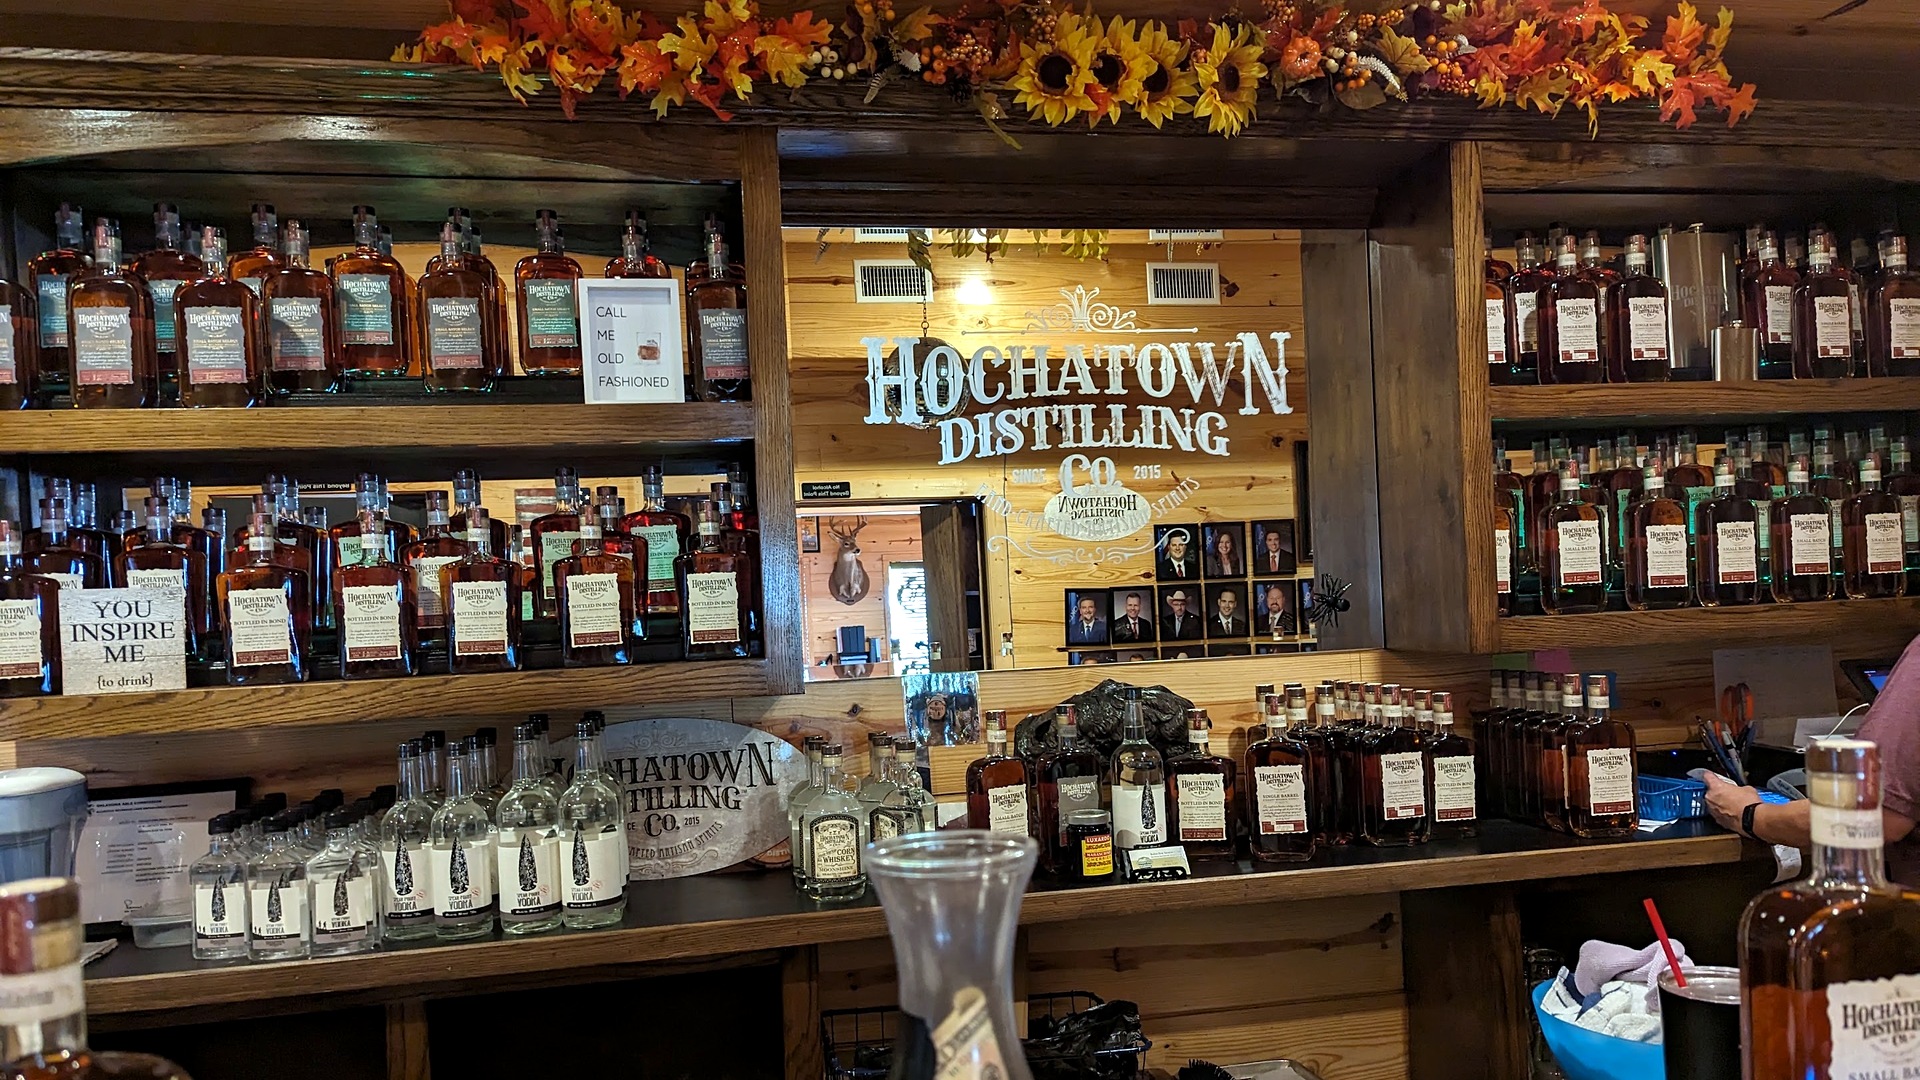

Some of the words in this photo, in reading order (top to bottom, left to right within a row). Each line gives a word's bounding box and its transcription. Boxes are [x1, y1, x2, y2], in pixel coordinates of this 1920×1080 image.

[343, 280, 387, 291] HOCHATOWN
[529, 285, 571, 295] HOCHATOWN
[273, 304, 318, 315] HOCHATOWN
[433, 304, 476, 314] HOCHATOWN
[596, 306, 627, 318] CALL
[1560, 304, 1594, 314] HOCHATOWN
[1632, 303, 1664, 312] HOCHATOWN
[79, 314, 126, 325] HOCHATOWN
[190, 314, 239, 324] HOCHATOWN
[703, 315, 745, 325] HOCHATOWN
[597, 330, 615, 341] ME
[598, 353, 624, 364] OLD
[599, 376, 669, 388] FASHIONED
[860, 331, 1294, 424] HOCHATOWN
[937, 403, 1230, 465] DISTILLING
[1012, 468, 1047, 483] SINCE
[1133, 464, 1161, 480] 2015
[1152, 476, 1200, 518] SPIRITS
[1794, 519, 1826, 528] HOCHATOWN
[1870, 518, 1900, 528] HOCHATOWN
[1562, 526, 1597, 536] HOCHATOWN
[1650, 530, 1684, 540] HOCHATOWN
[1721, 526, 1752, 536] HOCHATOWN
[132, 576, 179, 586] HOCHATOWN
[572, 579, 614, 589] HOCHATOWN
[692, 578, 733, 588] HOCHATOWN
[458, 586, 501, 597] HOCHATOWN
[234, 595, 282, 606] HOCHATOWN
[348, 592, 392, 602] HOCHATOWN
[93, 600, 152, 619] YOU
[71, 622, 176, 642] INSPIRE
[104, 645, 146, 664] ME
[1385, 758, 1420, 768] HOCHATOWN
[1592, 754, 1628, 764] HOCHATOWN
[552, 741, 777, 788] HATOWN
[1438, 761, 1472, 770] HOCHATOWN
[1259, 771, 1300, 782] HOCHATOWN
[1061, 782, 1096, 794] HOCHATOWN
[1182, 779, 1220, 789] HOCHATOWN
[626, 785, 742, 814] TILLING
[992, 792, 1024, 805] HOCHATOWN
[684, 816, 700, 826] 2015
[658, 840, 694, 858] ARTISAN
[697, 821, 723, 846] SPIRITS
[1140, 834, 1159, 843] VODKA
[836, 848, 855, 856] CORN
[822, 855, 856, 864] WHISKEY
[572, 892, 594, 900] VODKA
[393, 901, 418, 911] VODKA
[448, 899, 474, 910] VODKA
[517, 897, 542, 907] VODKA
[1842, 1000, 1920, 1030] HOCHATO
